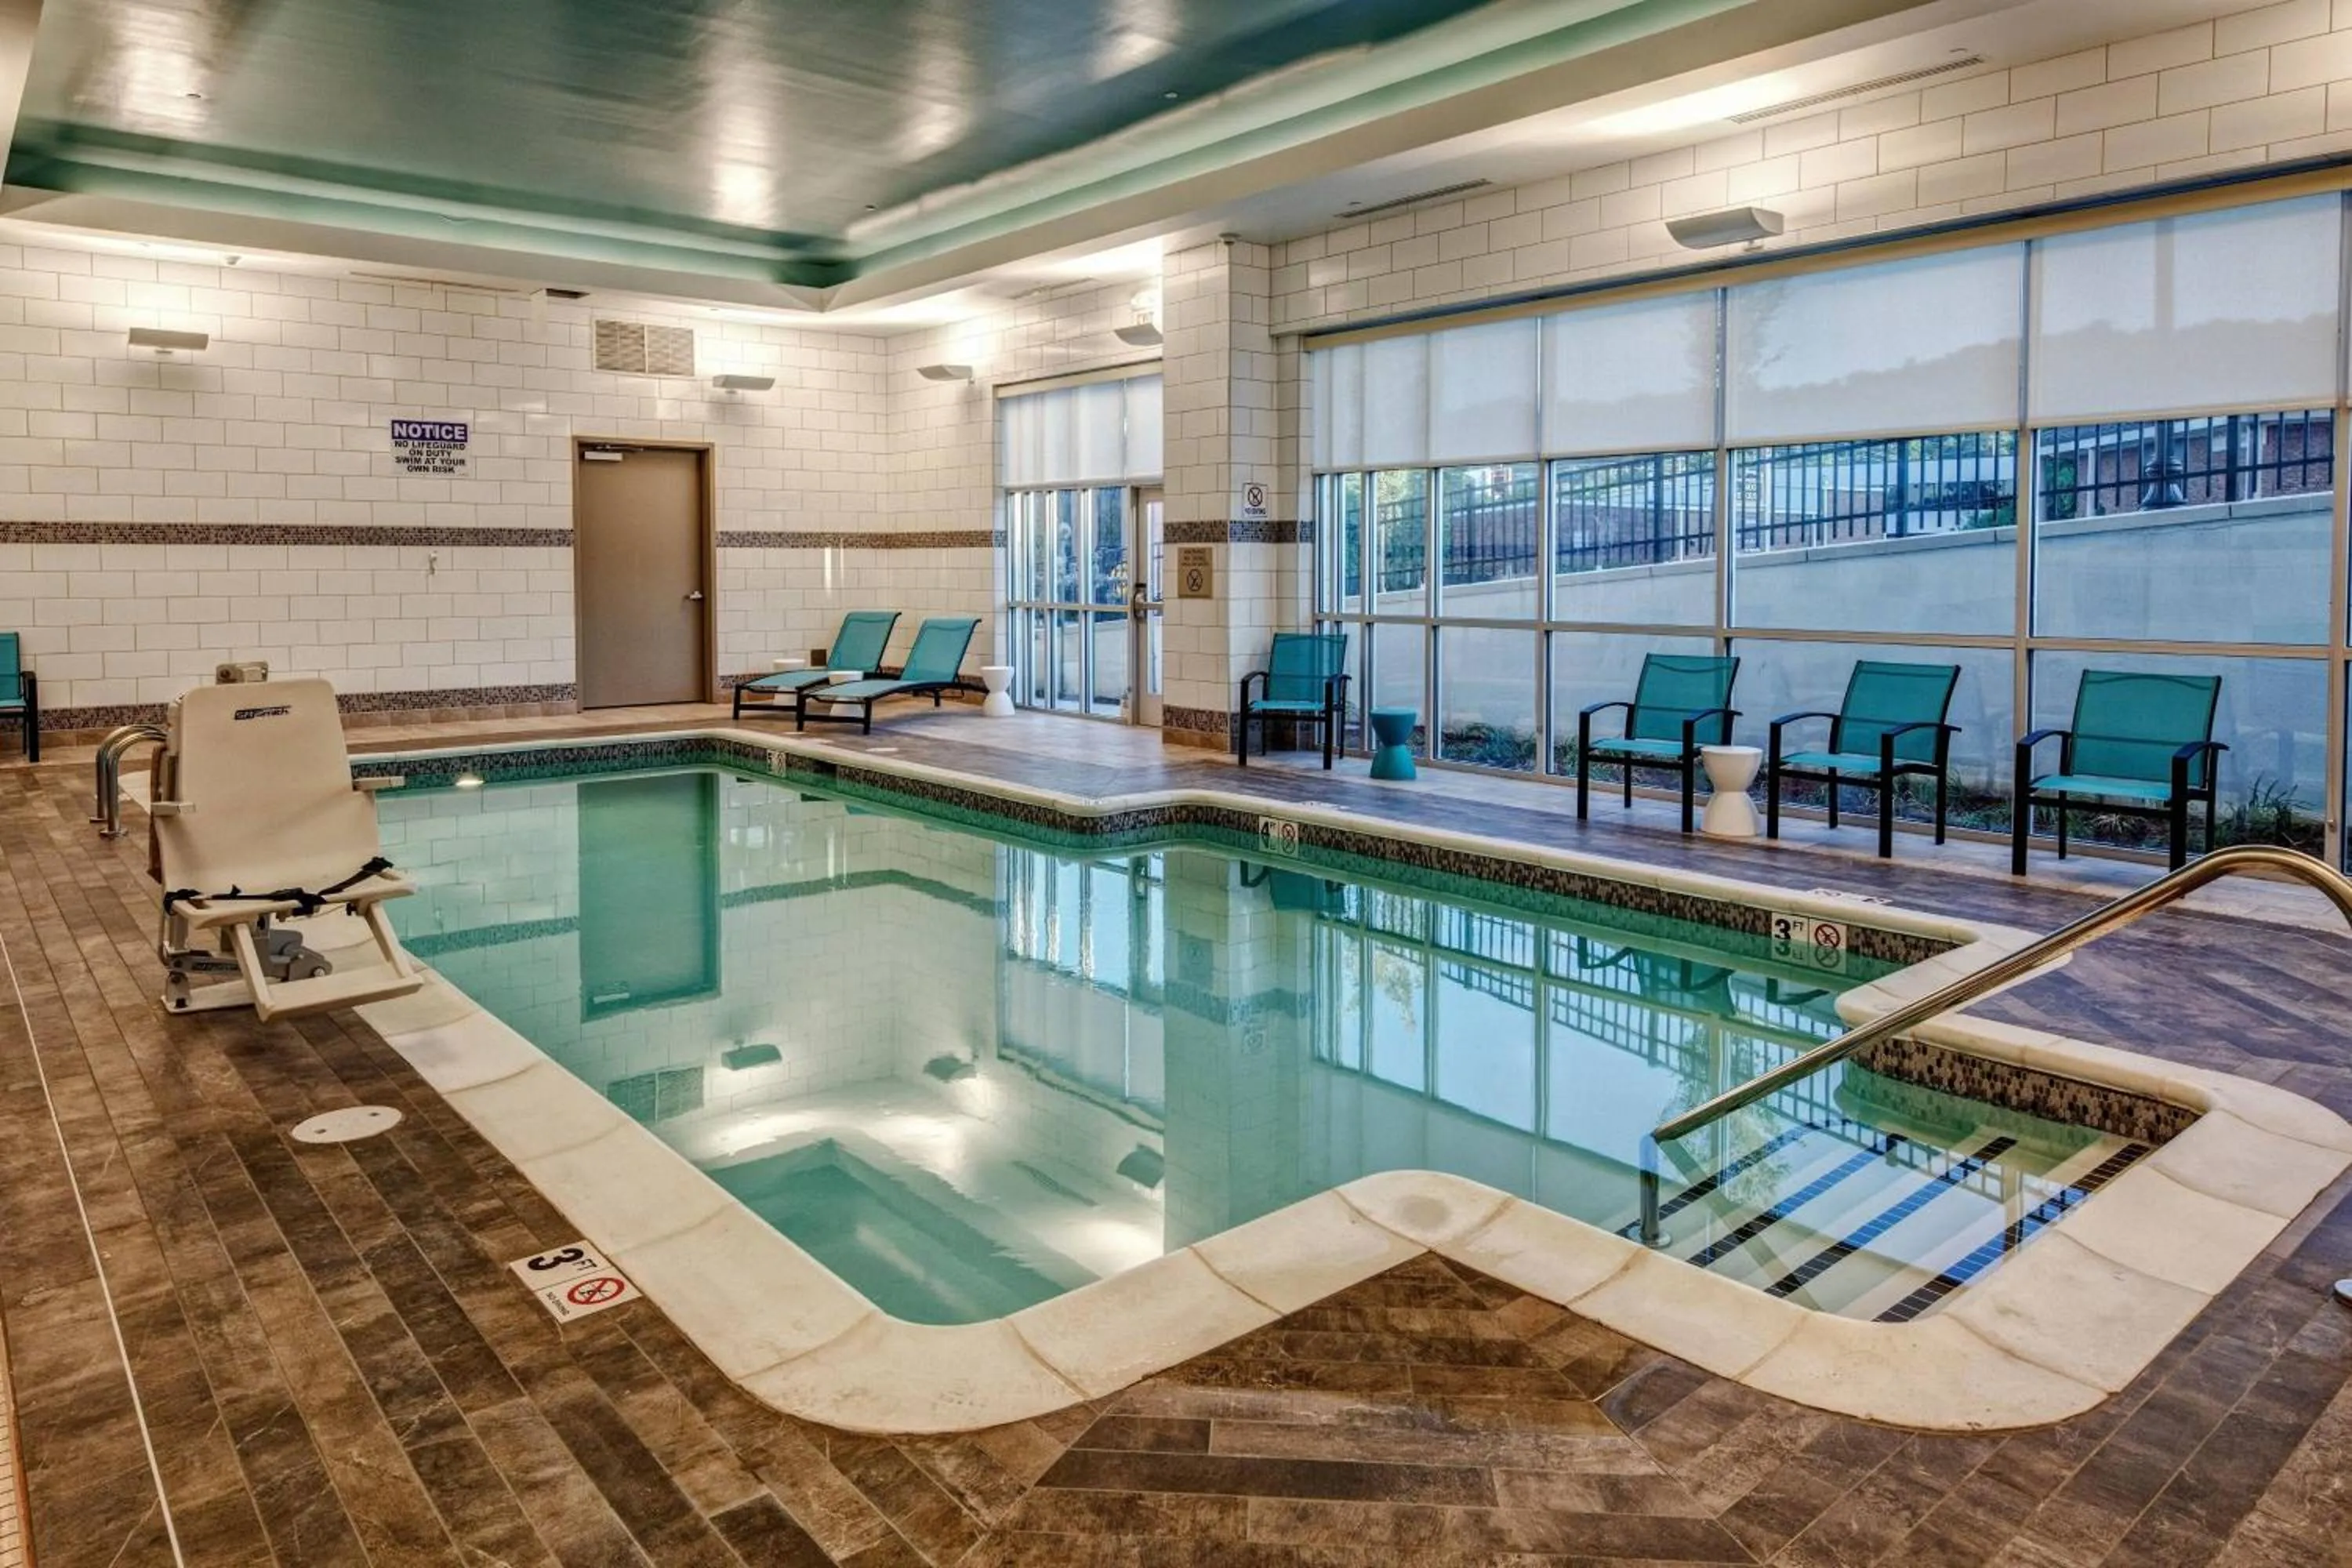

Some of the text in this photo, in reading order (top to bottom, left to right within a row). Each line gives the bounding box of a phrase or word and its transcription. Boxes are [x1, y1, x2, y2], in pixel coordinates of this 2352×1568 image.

[394, 423, 465, 439] NOTICE
[412, 441, 466, 450] LIFEGUARD
[394, 456, 421, 464] SWIM
[1260, 820, 1270, 836] 4
[1774, 918, 1803, 940] 3 FT
[527, 1248, 597, 1271] 3 FT
